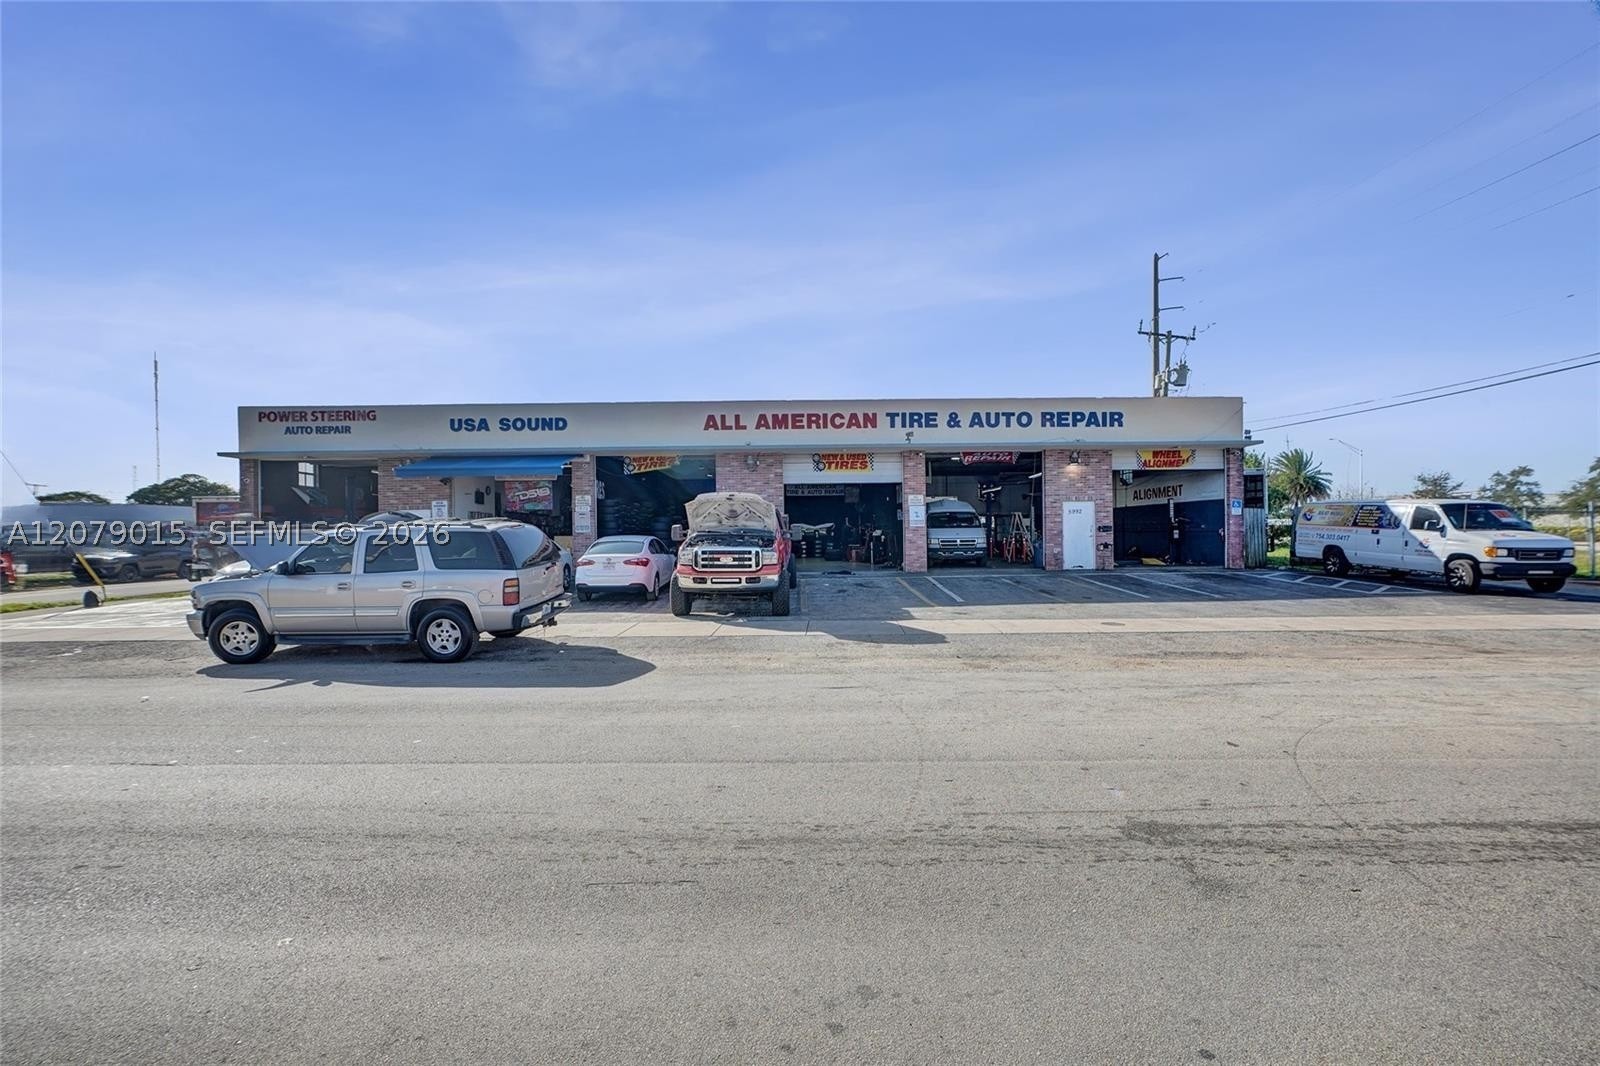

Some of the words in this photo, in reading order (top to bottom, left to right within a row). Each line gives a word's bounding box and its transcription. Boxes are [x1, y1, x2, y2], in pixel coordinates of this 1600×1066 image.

[258, 411, 308, 422] POWER
[310, 410, 377, 422] STEERING
[703, 414, 747, 430] ALL
[754, 412, 878, 430] AMERICAN
[885, 412, 938, 428] TIRE
[946, 412, 962, 428] &
[968, 412, 1033, 428] AUTO
[1040, 411, 1124, 428] REPAIR
[284, 426, 313, 435] AUTO
[315, 425, 352, 434] REPAIR
[449, 418, 490, 432] USA
[498, 416, 568, 432] SOUND
[1152, 450, 1183, 459] WHEEL
[825, 461, 868, 470] TIRES
[1132, 484, 1183, 501] ALIGNMENT
